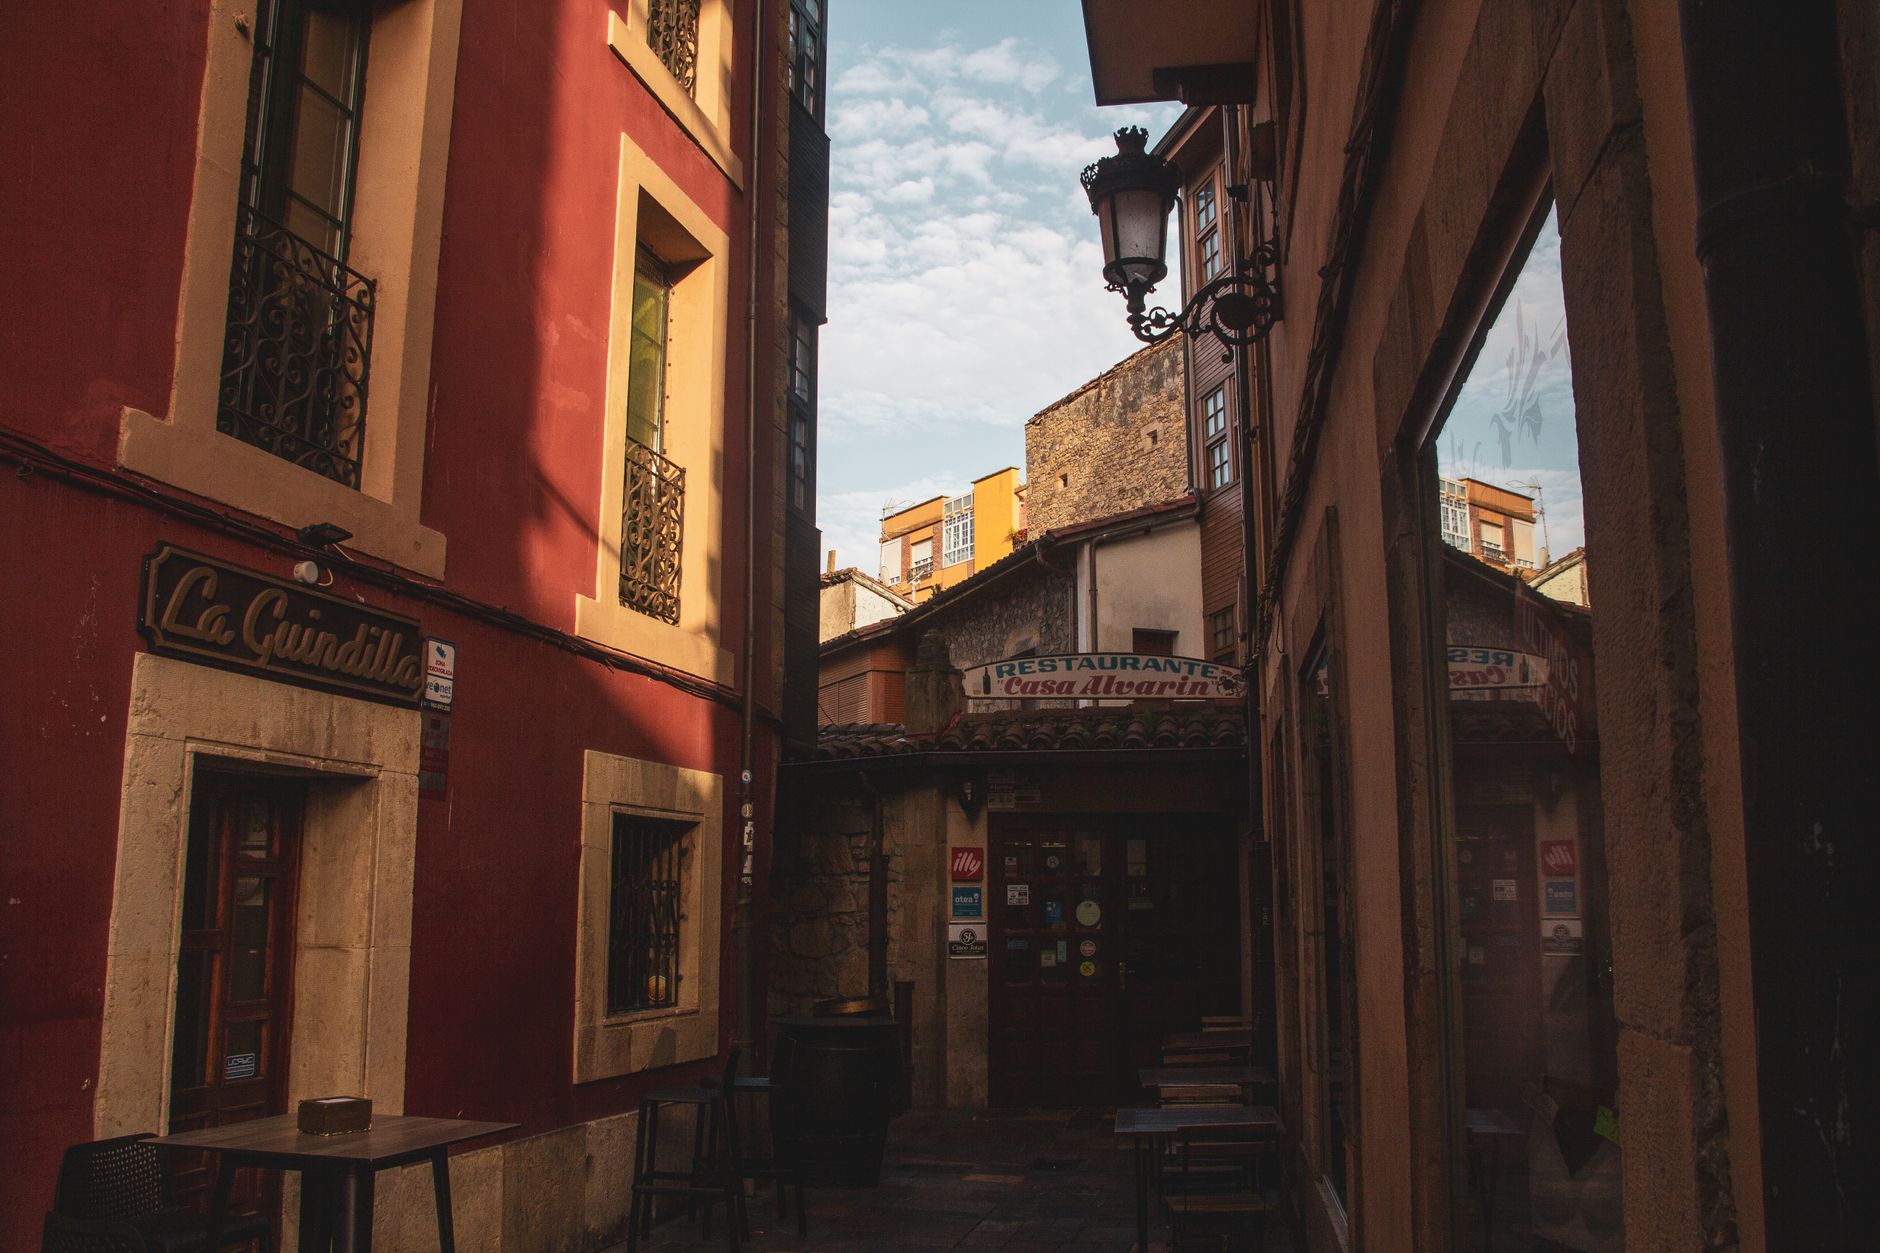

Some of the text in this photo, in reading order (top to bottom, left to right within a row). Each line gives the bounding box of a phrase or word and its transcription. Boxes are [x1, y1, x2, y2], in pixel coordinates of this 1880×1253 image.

[161, 566, 420, 689] La Guindilla
[995, 656, 1218, 680] RESTAURANTE
[953, 852, 981, 877] illy
